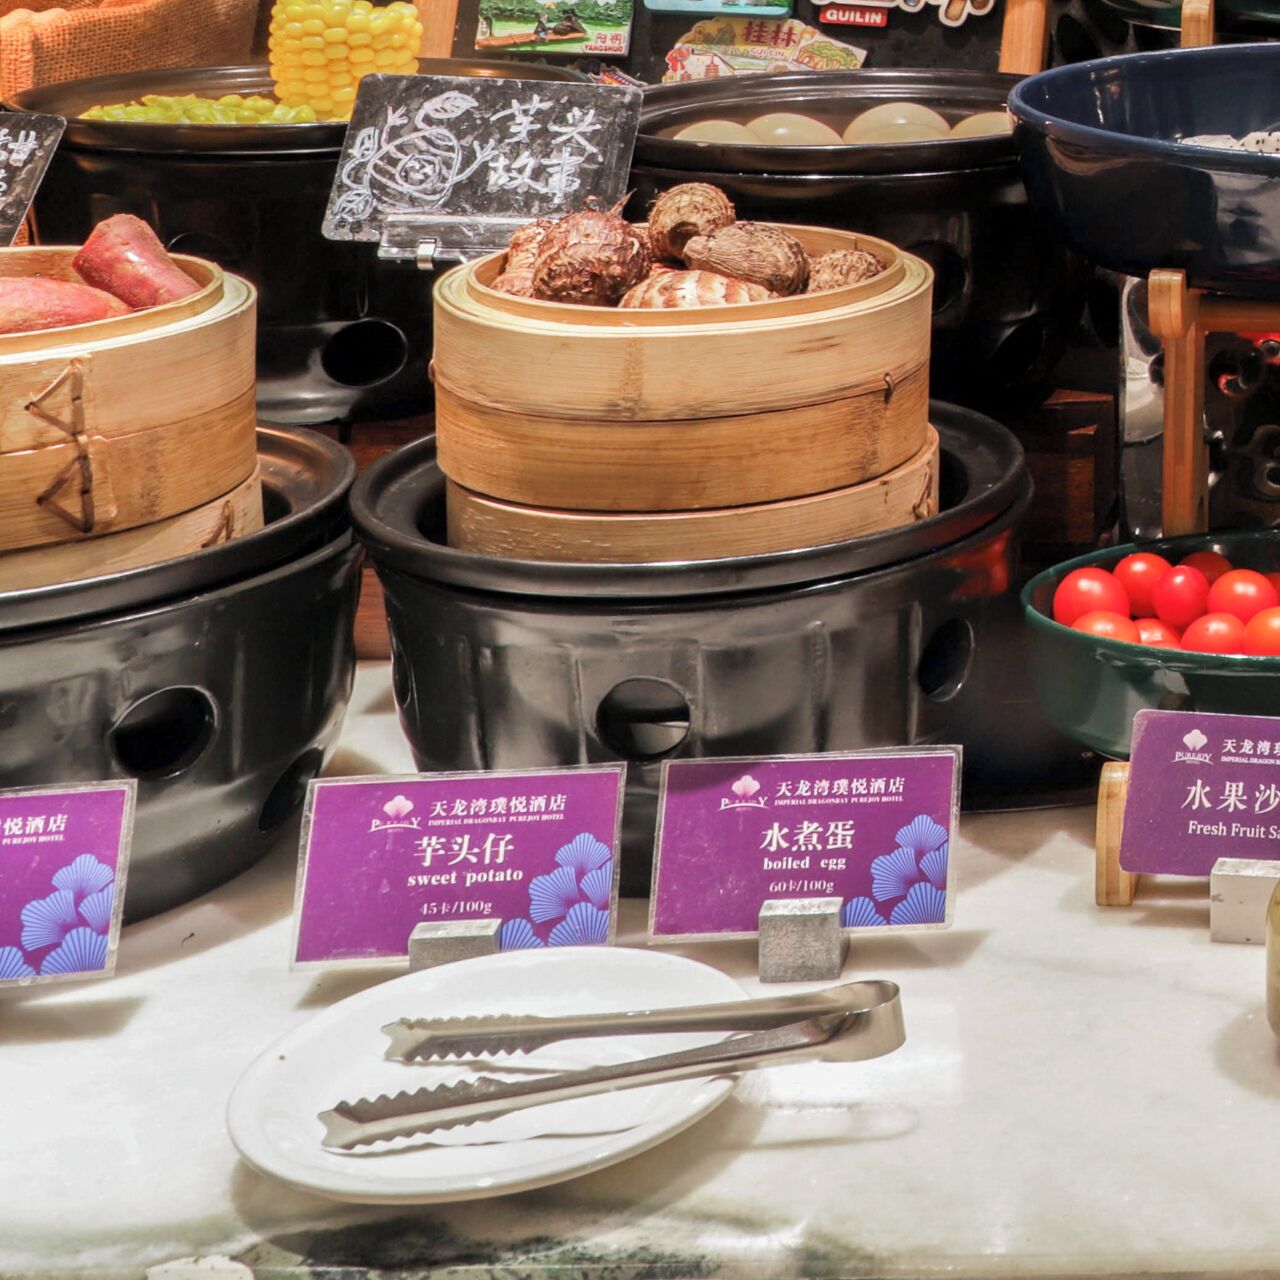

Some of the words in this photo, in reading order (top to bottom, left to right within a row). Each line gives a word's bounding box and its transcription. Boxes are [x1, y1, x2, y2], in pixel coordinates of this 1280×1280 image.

[826, 9, 882, 24] GUILIN
[742, 21, 797, 47] 桂林
[775, 776, 906, 798] 天龙湾璞悦酒店
[428, 794, 567, 818] 天龙湾璞悦酒店
[759, 819, 856, 852] 水煮蛋
[1188, 820, 1227, 836] Fresh
[1231, 823, 1265, 839] Fruit
[413, 832, 515, 868] 芋头仔
[763, 856, 810, 871] boiled
[820, 856, 847, 871] egg
[407, 871, 457, 887] sweet
[465, 867, 524, 888] potato
